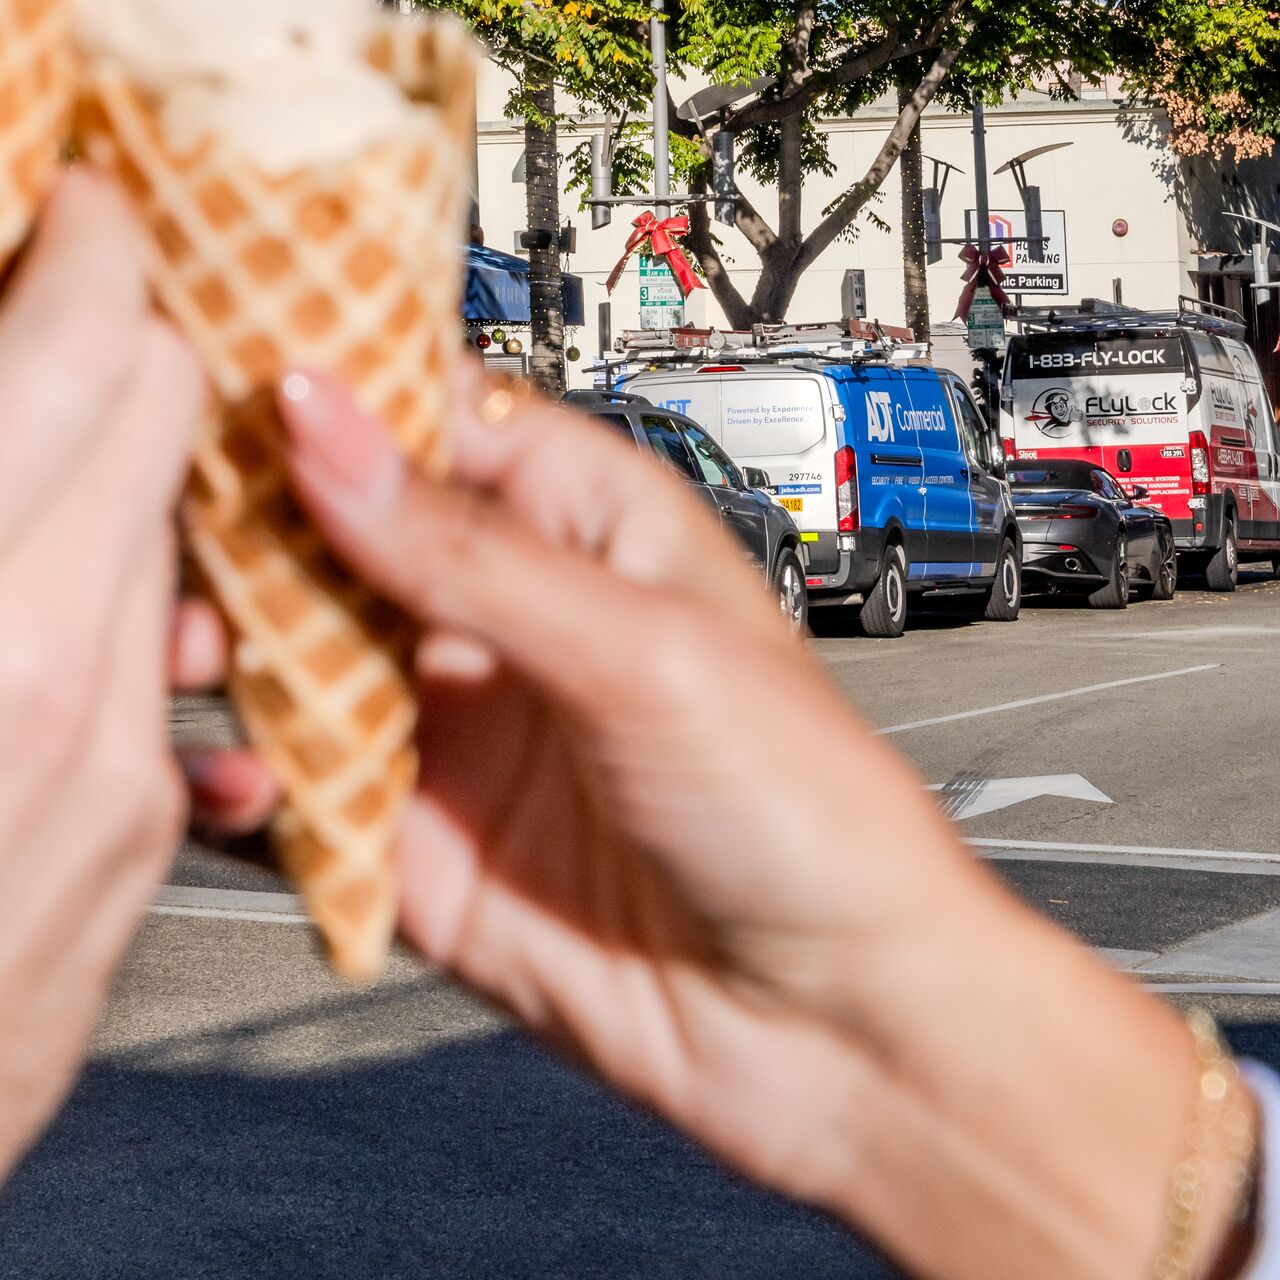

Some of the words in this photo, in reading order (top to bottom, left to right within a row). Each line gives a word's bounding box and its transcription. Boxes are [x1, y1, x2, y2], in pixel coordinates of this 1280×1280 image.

[1016, 253, 1060, 264] PAING
[1018, 276, 1060, 289] Parking
[641, 288, 648, 300] 3
[1029, 349, 1166, 369] 1-833-FLY-LOCK
[761, 406, 770, 415] by
[727, 417, 751, 425] Driven
[753, 416, 762, 425] by
[864, 391, 895, 442] ADT
[895, 403, 946, 432] Commercial
[1086, 419, 1126, 427] SECURITY
[1130, 416, 1179, 425] SOLUTIONS
[789, 472, 822, 481] 297746
[780, 486, 821, 495] jobs.adt.com
